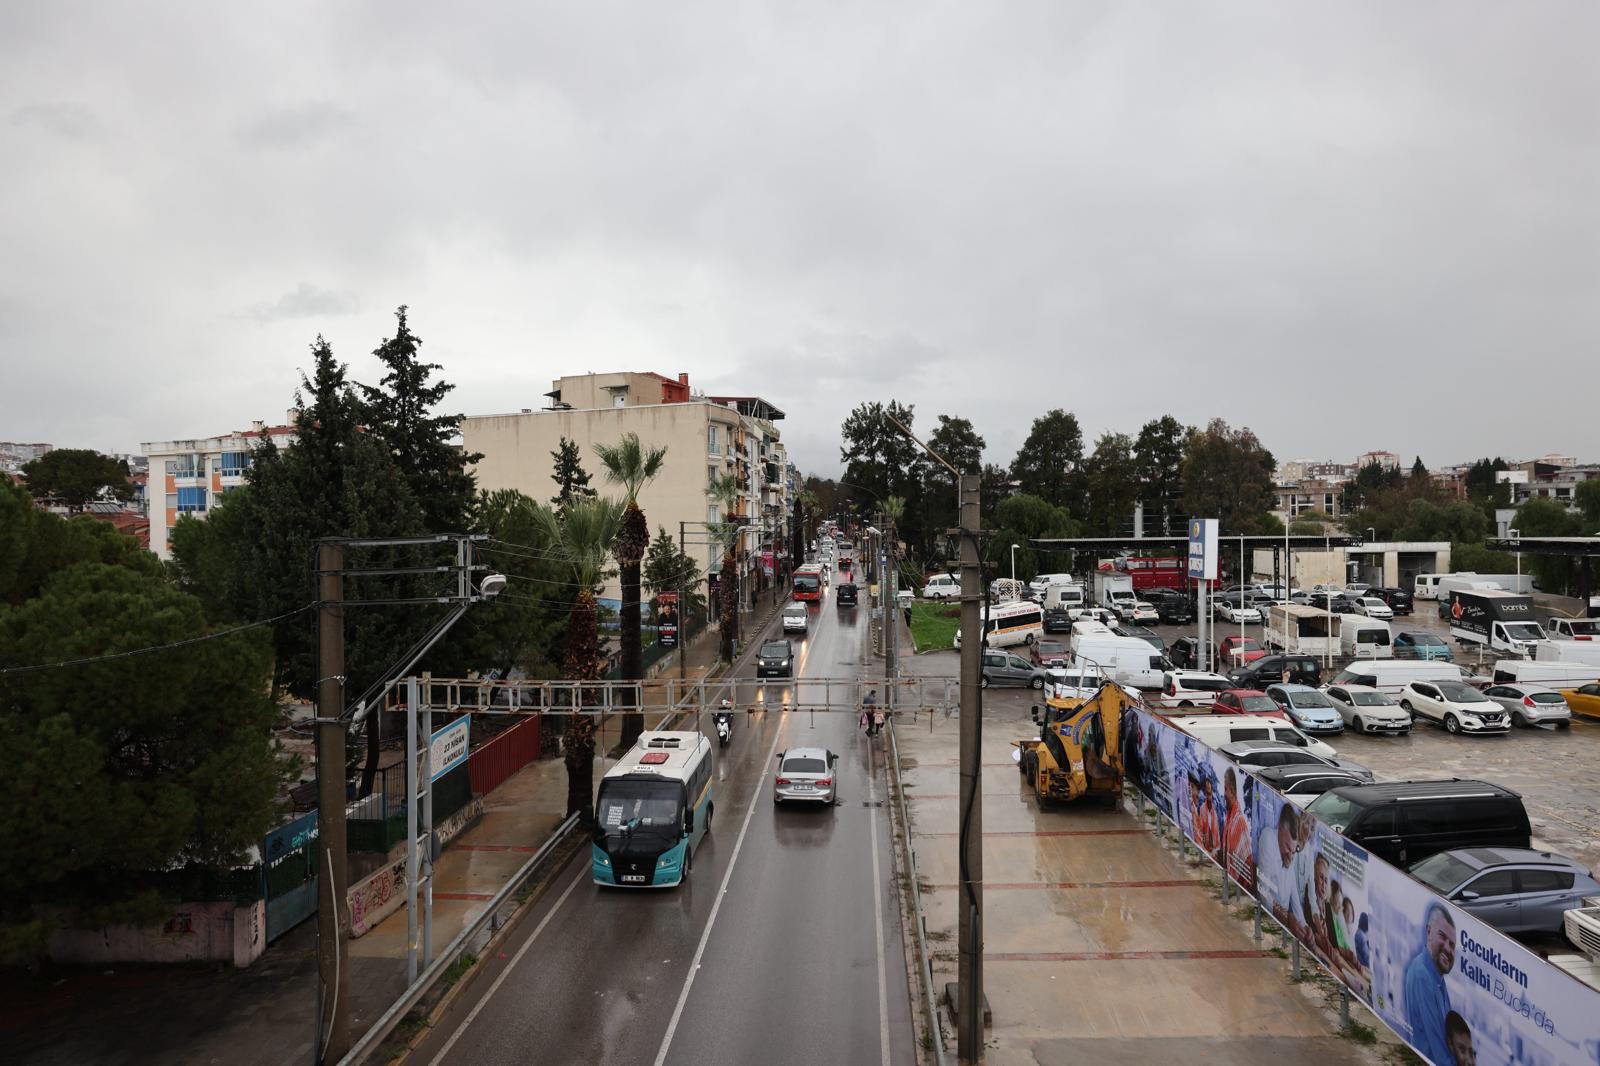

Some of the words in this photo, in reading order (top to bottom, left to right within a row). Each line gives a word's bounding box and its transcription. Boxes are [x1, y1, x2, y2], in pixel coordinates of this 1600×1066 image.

[1501, 603, 1529, 611] bambi
[1461, 930, 1528, 988] Çocukların
[1460, 956, 1491, 992] Kalbi
[1493, 979, 1555, 1036] Buca'da
